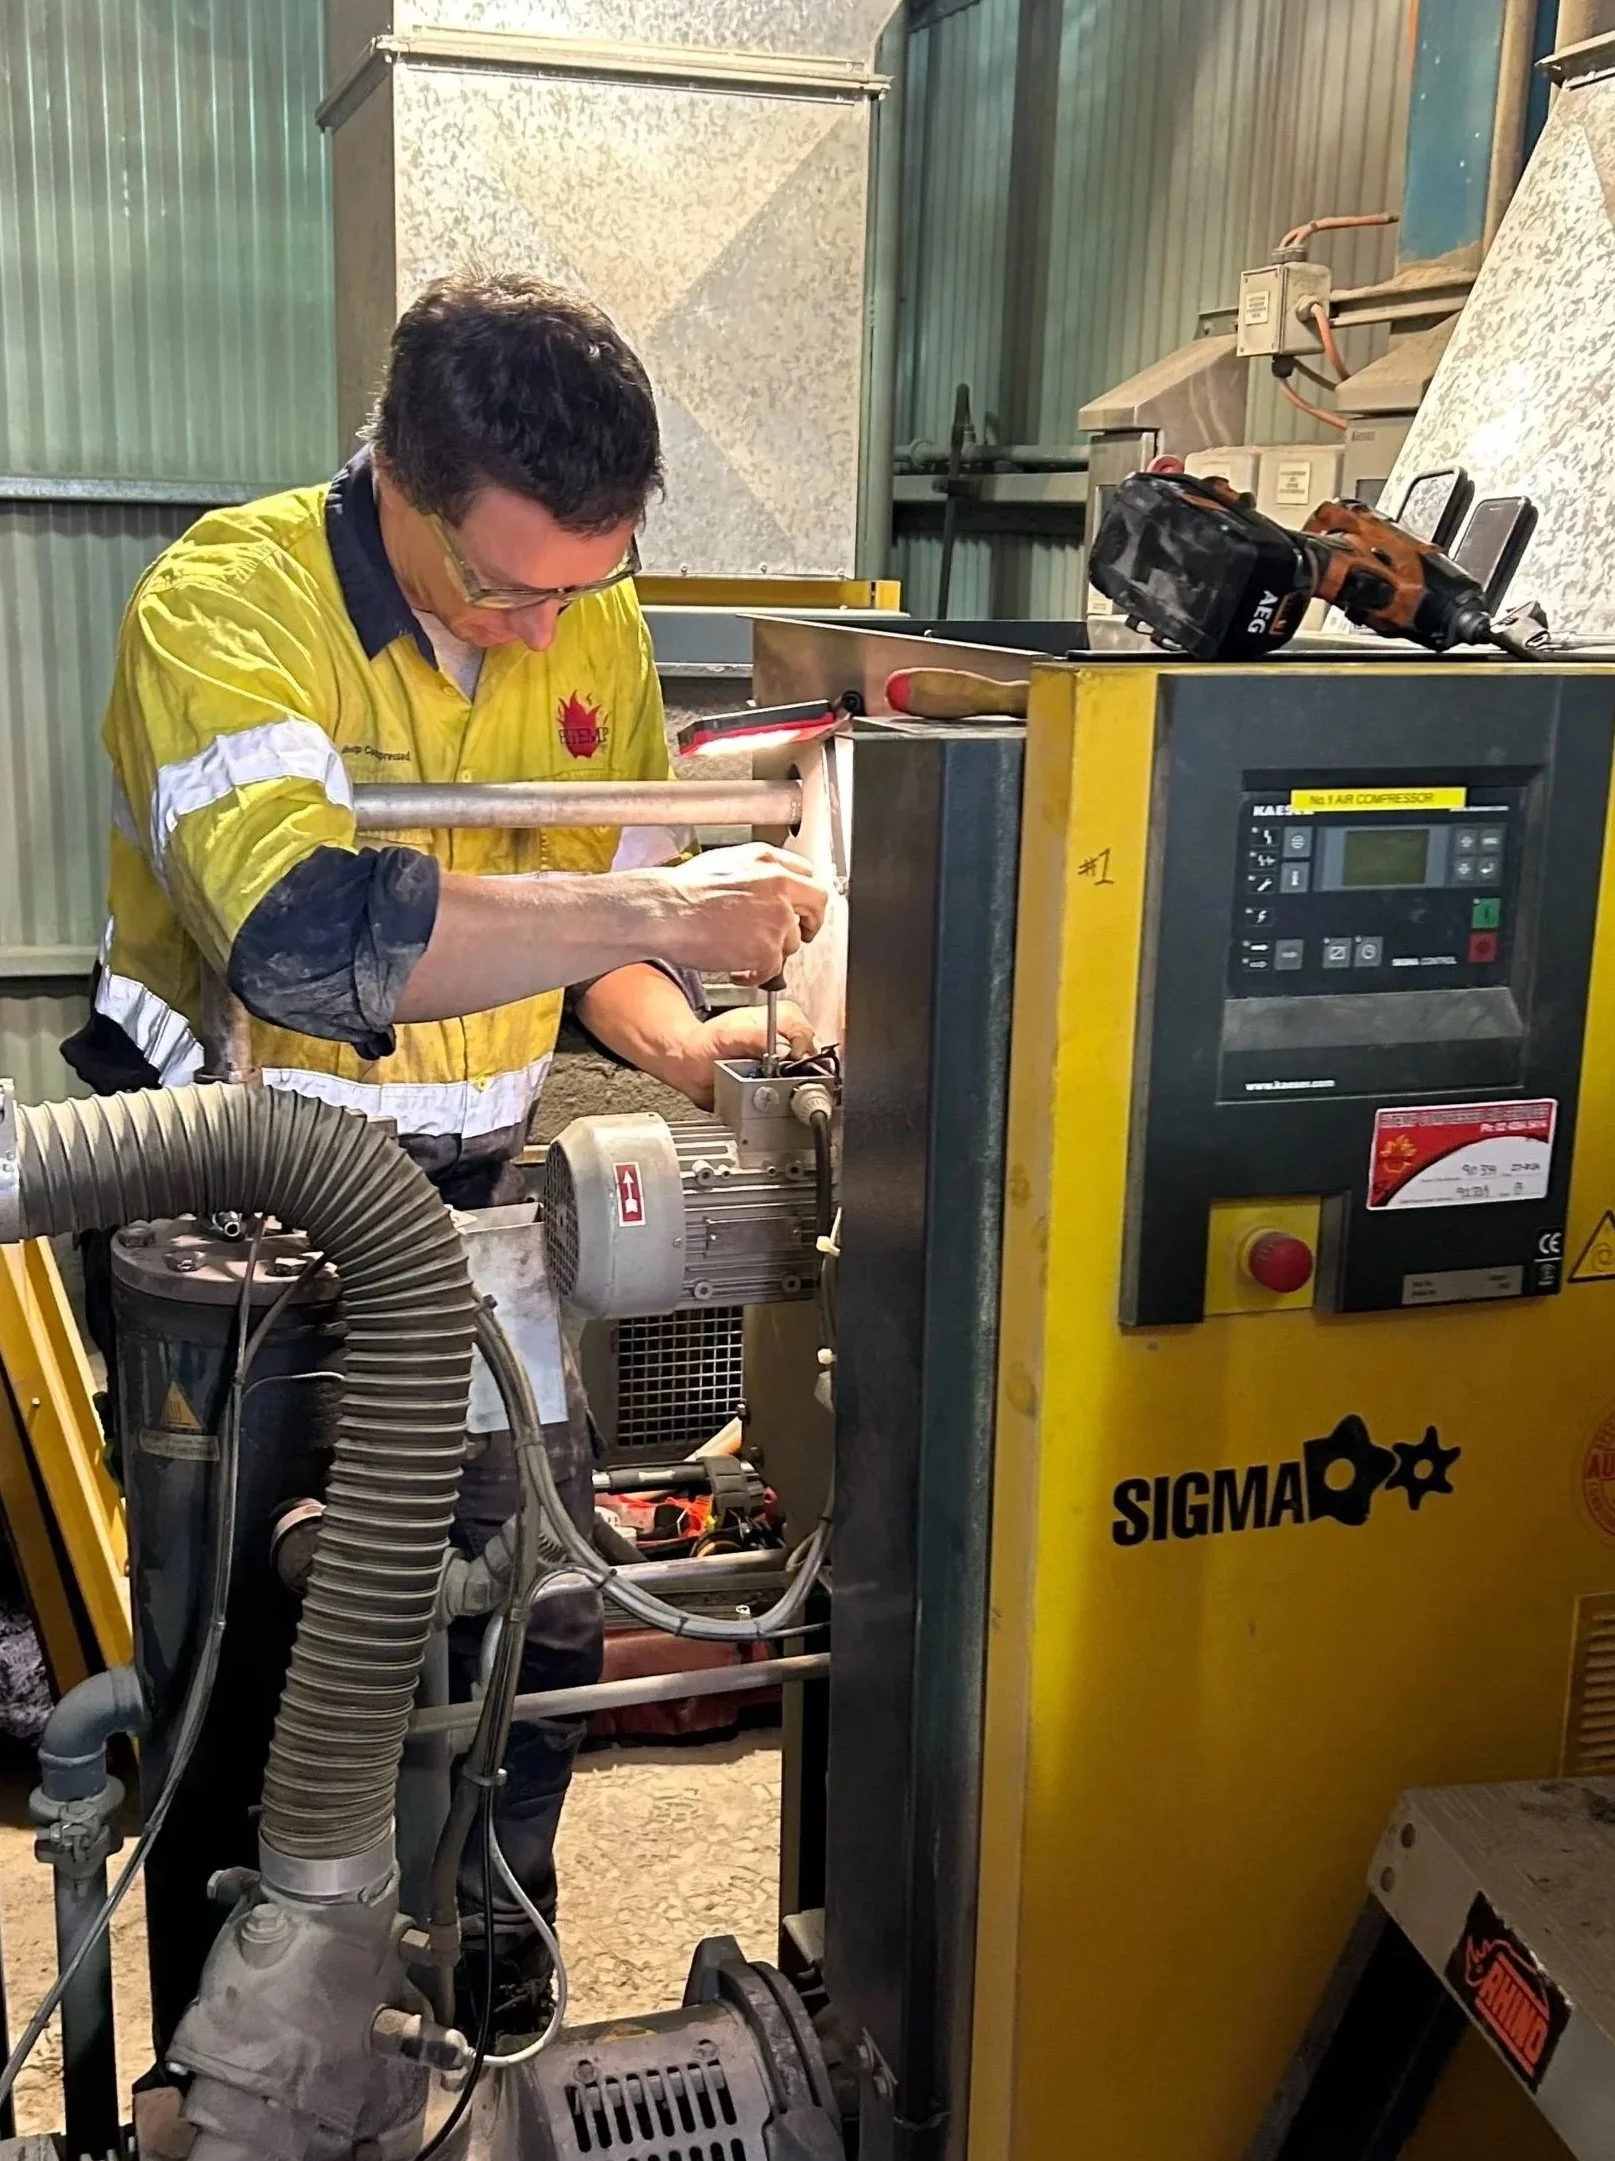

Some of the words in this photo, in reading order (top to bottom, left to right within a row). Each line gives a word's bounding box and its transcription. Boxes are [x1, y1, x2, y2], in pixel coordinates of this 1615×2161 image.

[1247, 590, 1279, 634] AEG
[1335, 793, 1353, 804] AIR
[1356, 792, 1434, 804] COMPRESSOR
[1077, 847, 1115, 886] #1
[1538, 1233, 1562, 1254] CE
[1112, 1460, 1305, 1547] SIGMA
[1477, 1959, 1549, 2066] RHINO
